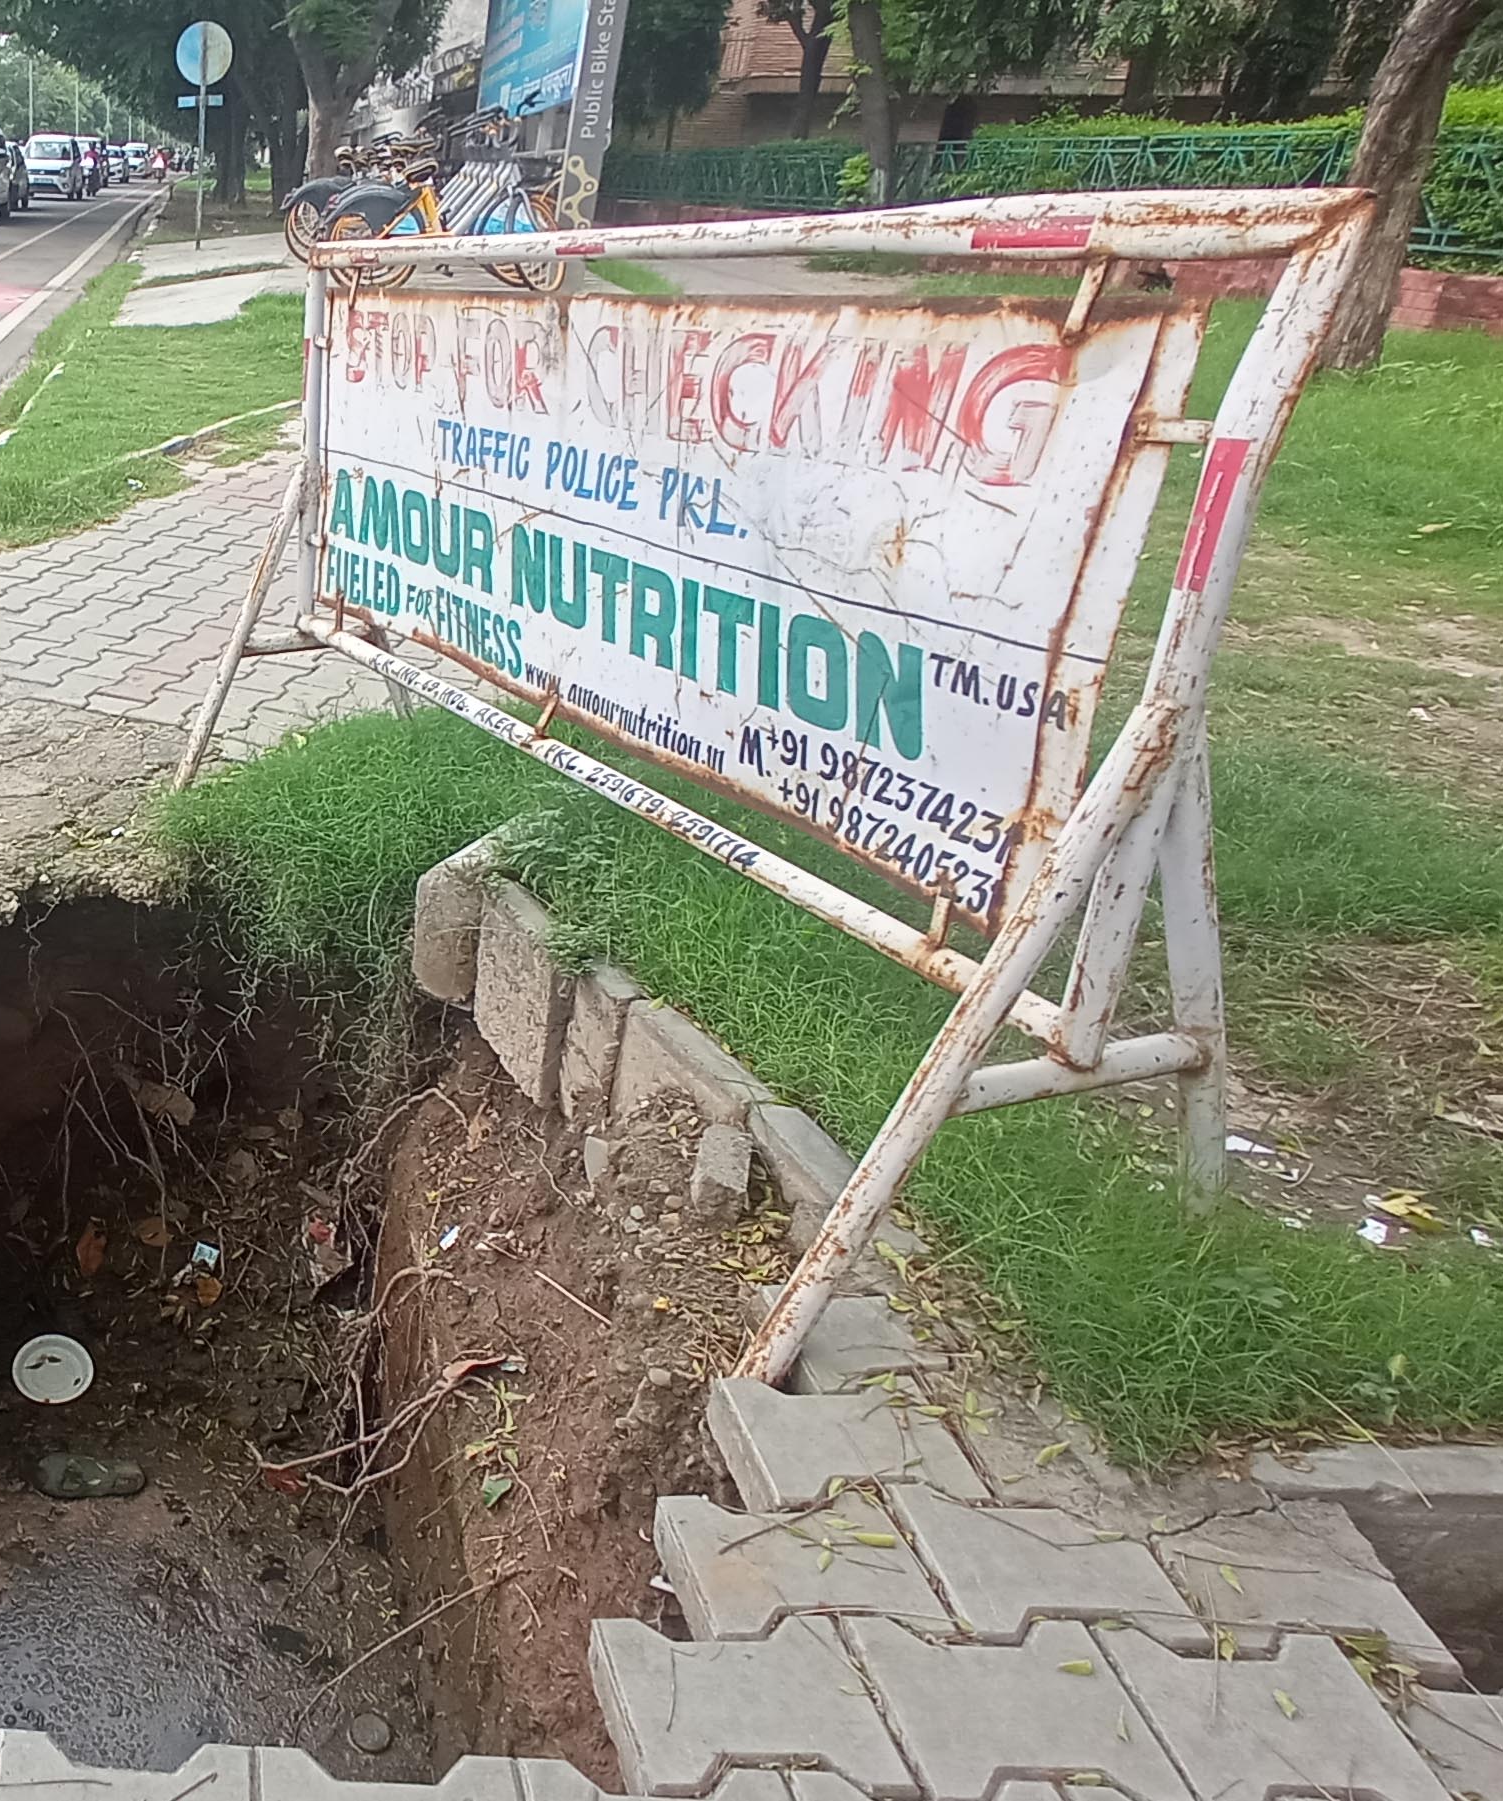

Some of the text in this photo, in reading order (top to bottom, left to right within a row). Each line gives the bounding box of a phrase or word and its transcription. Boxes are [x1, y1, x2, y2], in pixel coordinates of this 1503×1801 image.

[580, 80, 605, 139] Public
[590, 31, 612, 74] Bike
[344, 309, 1077, 489] STOP FOR CHECKING
[436, 418, 749, 540] TRAFFIC POLICE PKL.
[325, 543, 524, 680] FUELED FOR FITNESS
[329, 467, 925, 762] AMOUR NUTRITION
[819, 742, 1016, 865] 9872374231
